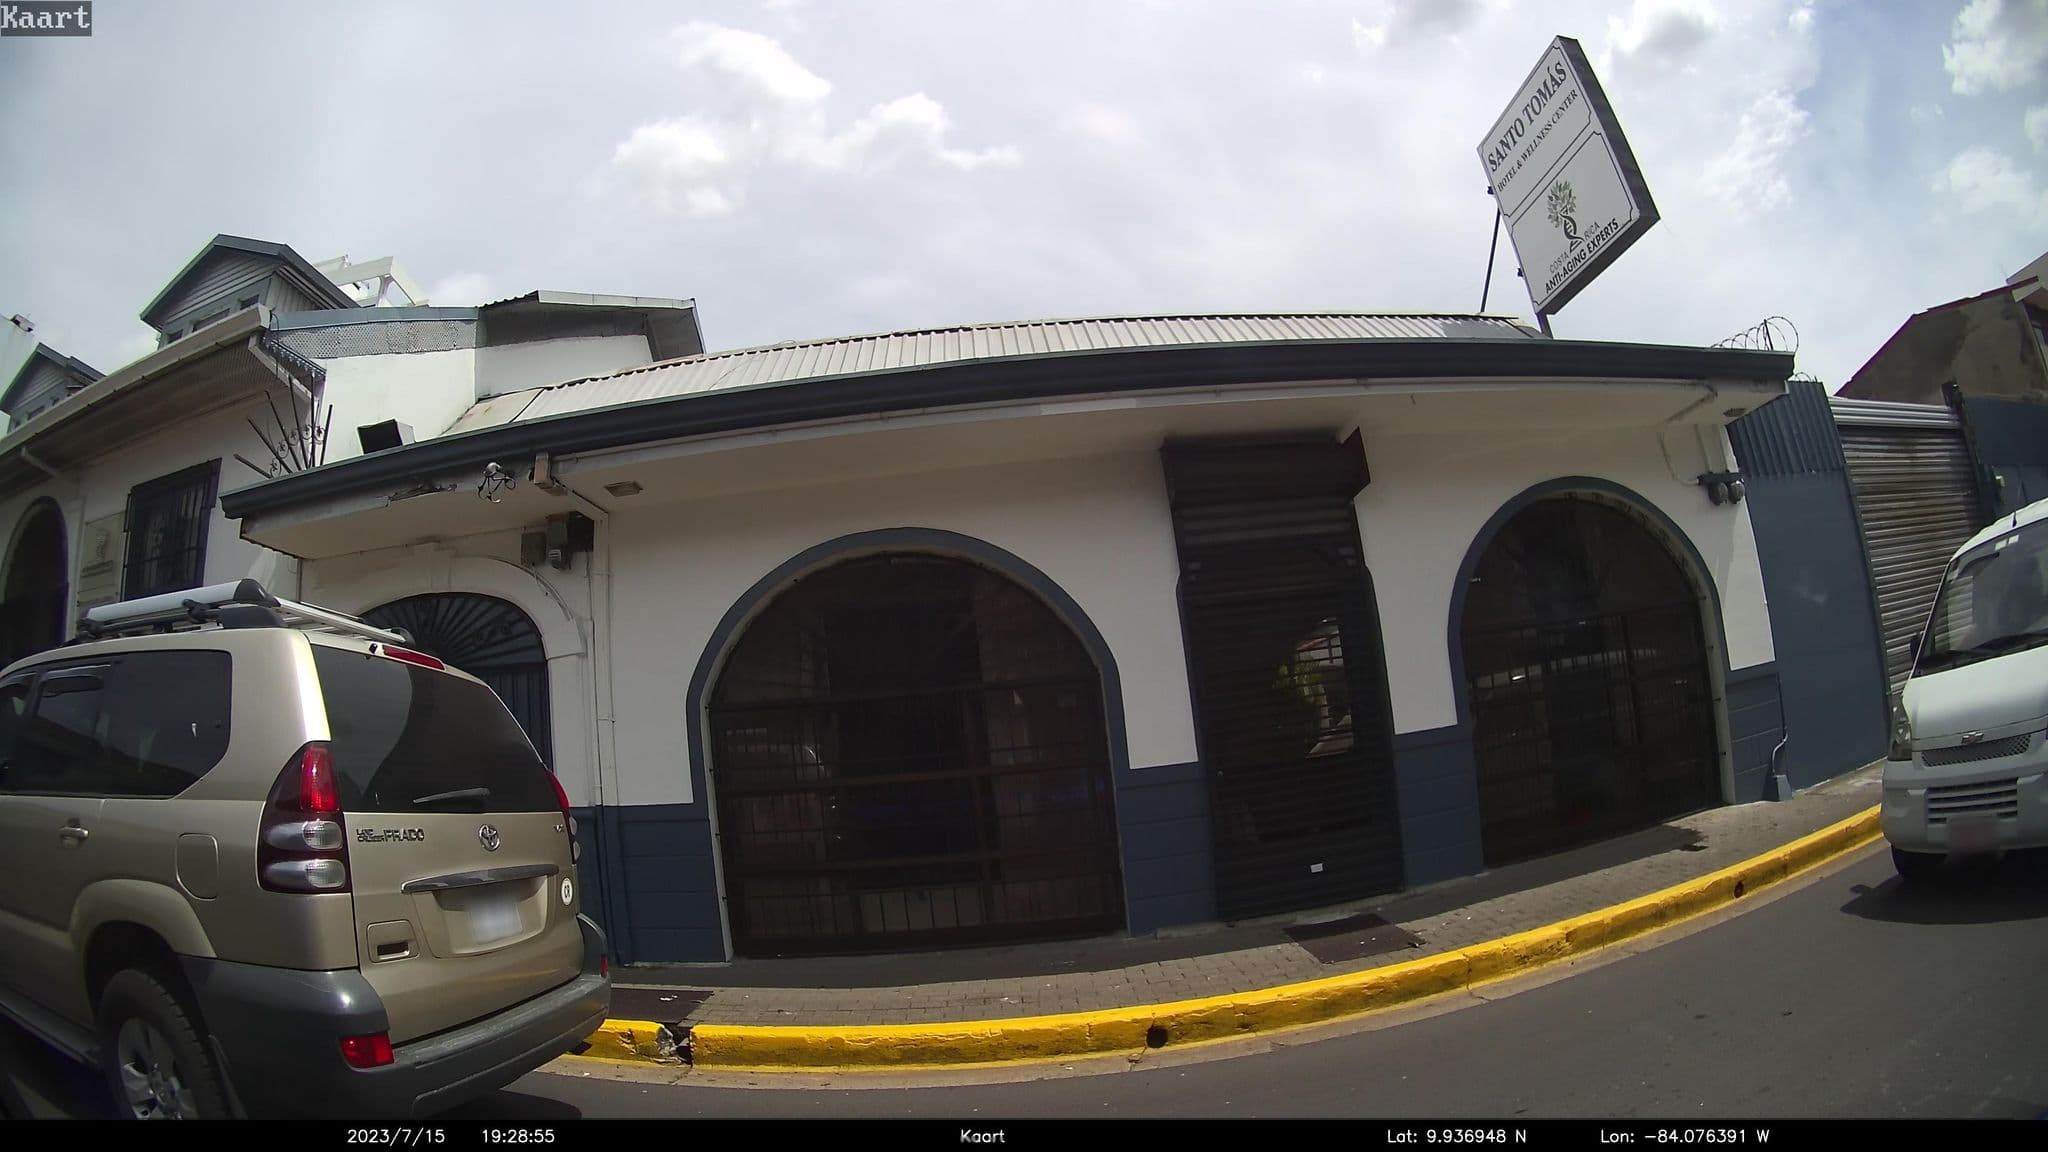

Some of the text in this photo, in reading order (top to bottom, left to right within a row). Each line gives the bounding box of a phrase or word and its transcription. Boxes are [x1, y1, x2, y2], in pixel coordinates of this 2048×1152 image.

[1487, 61, 1567, 172] SANTO TOMÁS
[1497, 89, 1578, 192] HOTEL & WELLNESS CENTER
[1544, 217, 1620, 294] ANTI-AGING EXPERTS
[1549, 221, 1600, 273] COSTA RICA
